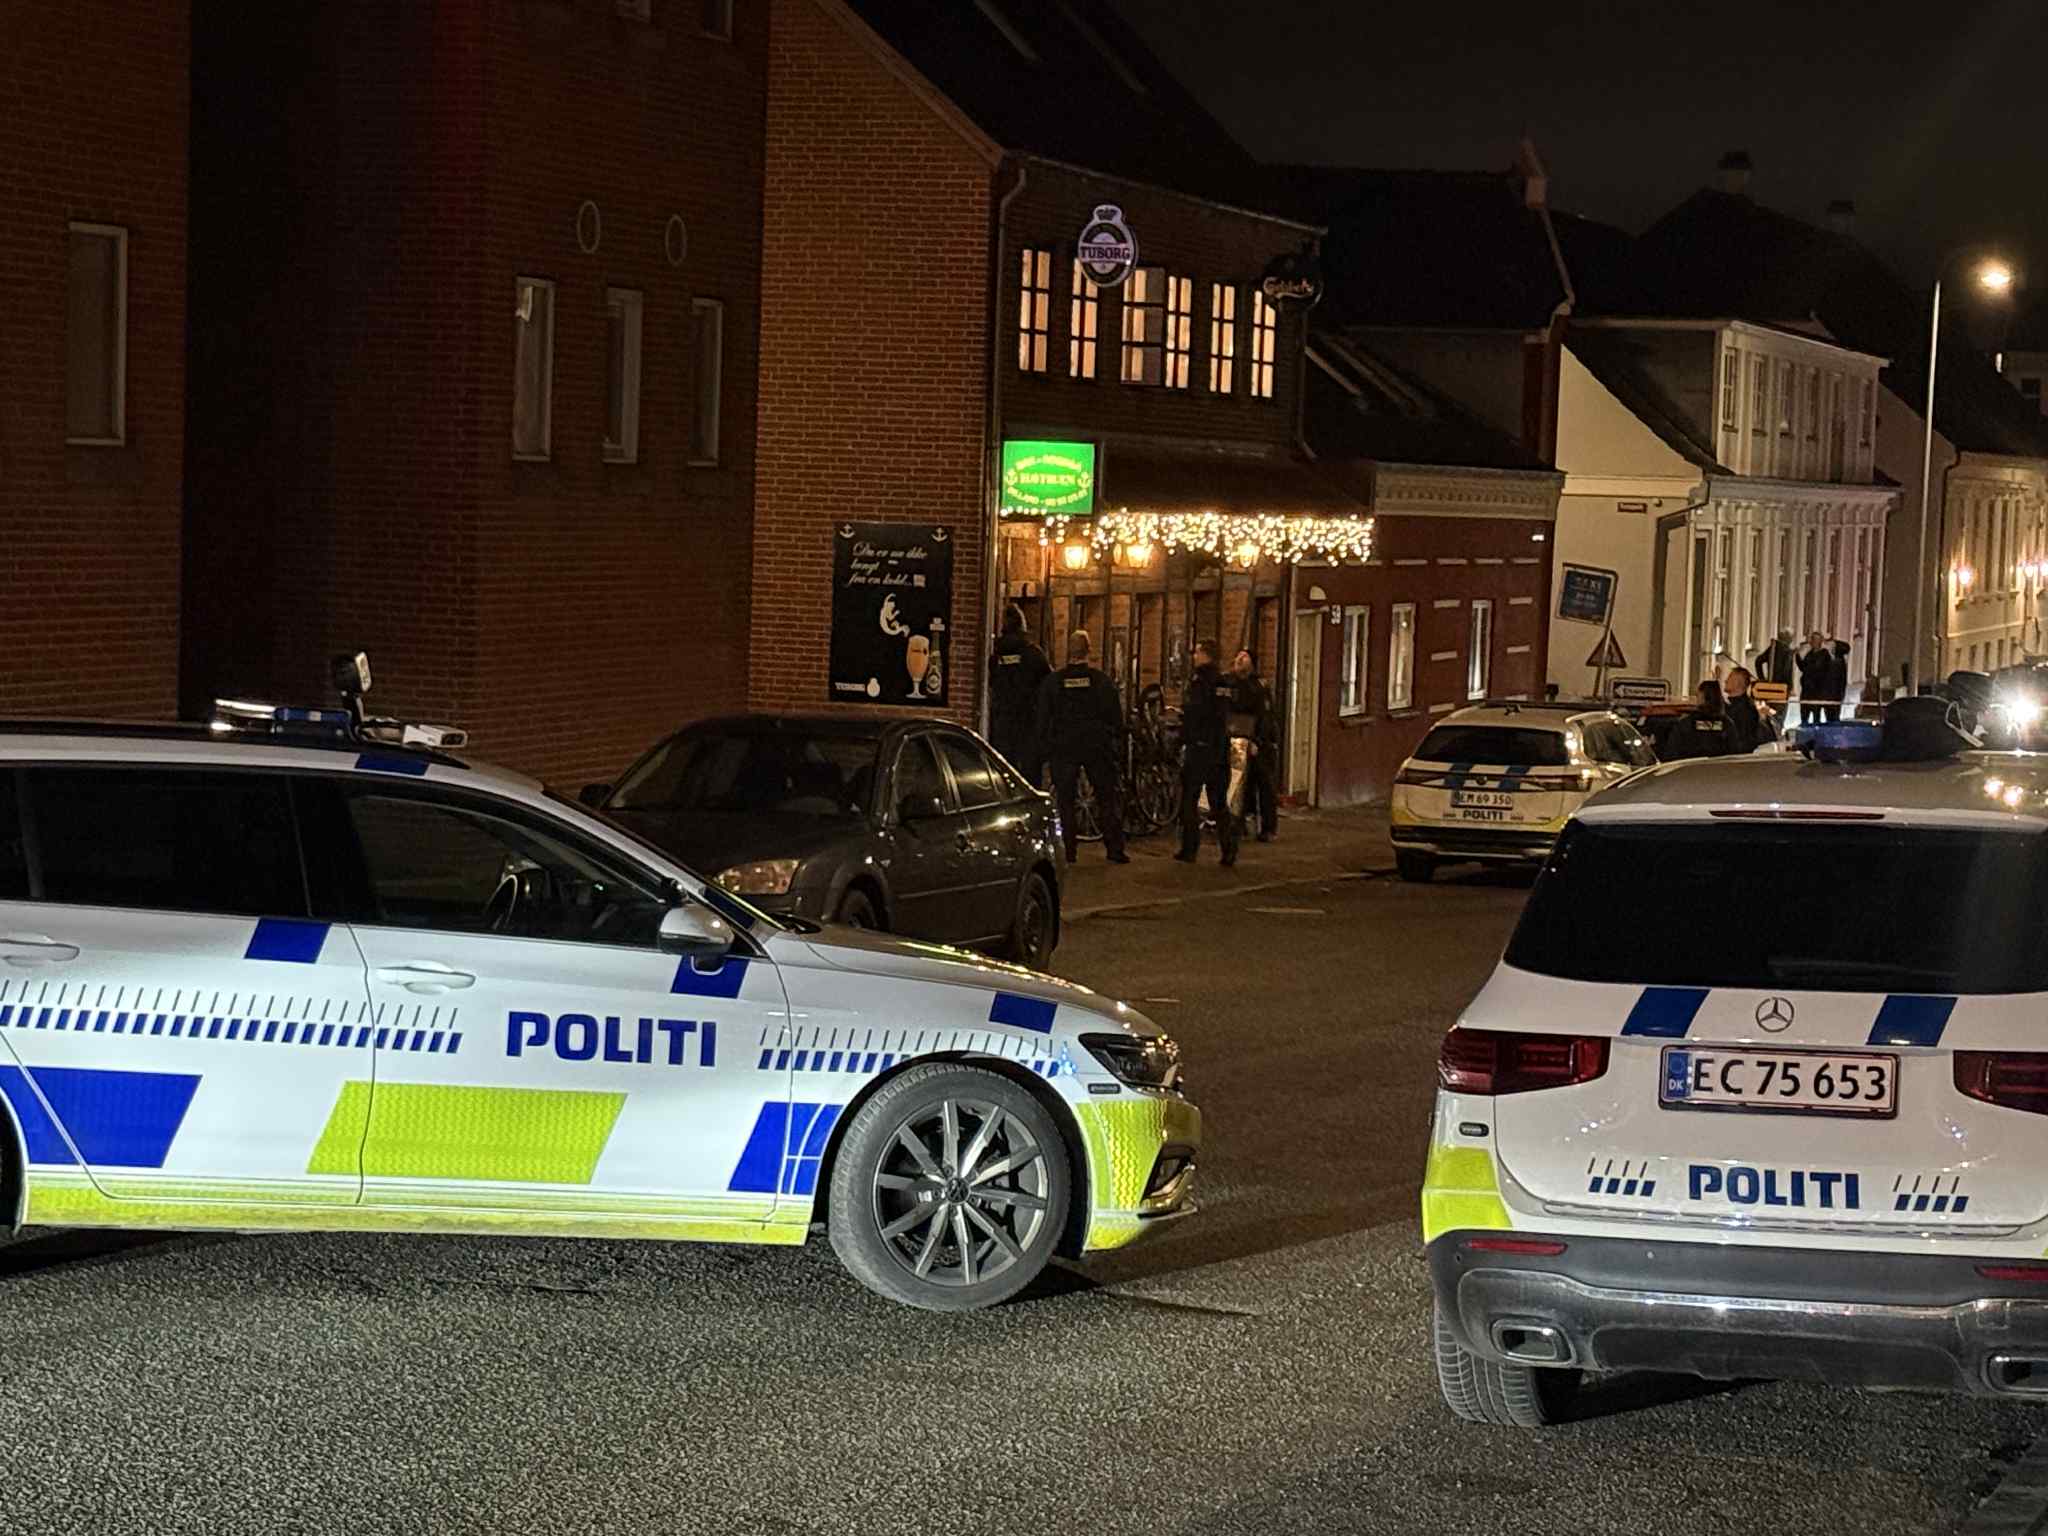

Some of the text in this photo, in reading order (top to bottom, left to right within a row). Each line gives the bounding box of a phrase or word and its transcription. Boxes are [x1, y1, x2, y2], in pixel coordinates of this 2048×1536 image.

[1080, 246, 1130, 260] TUBORG
[1463, 810, 1503, 820] POLITI
[507, 1011, 716, 1067] POLITI
[1669, 1078, 1684, 1090] DK
[1693, 1058, 1886, 1101] EC 75 653
[1688, 1165, 1860, 1209] POLITI
